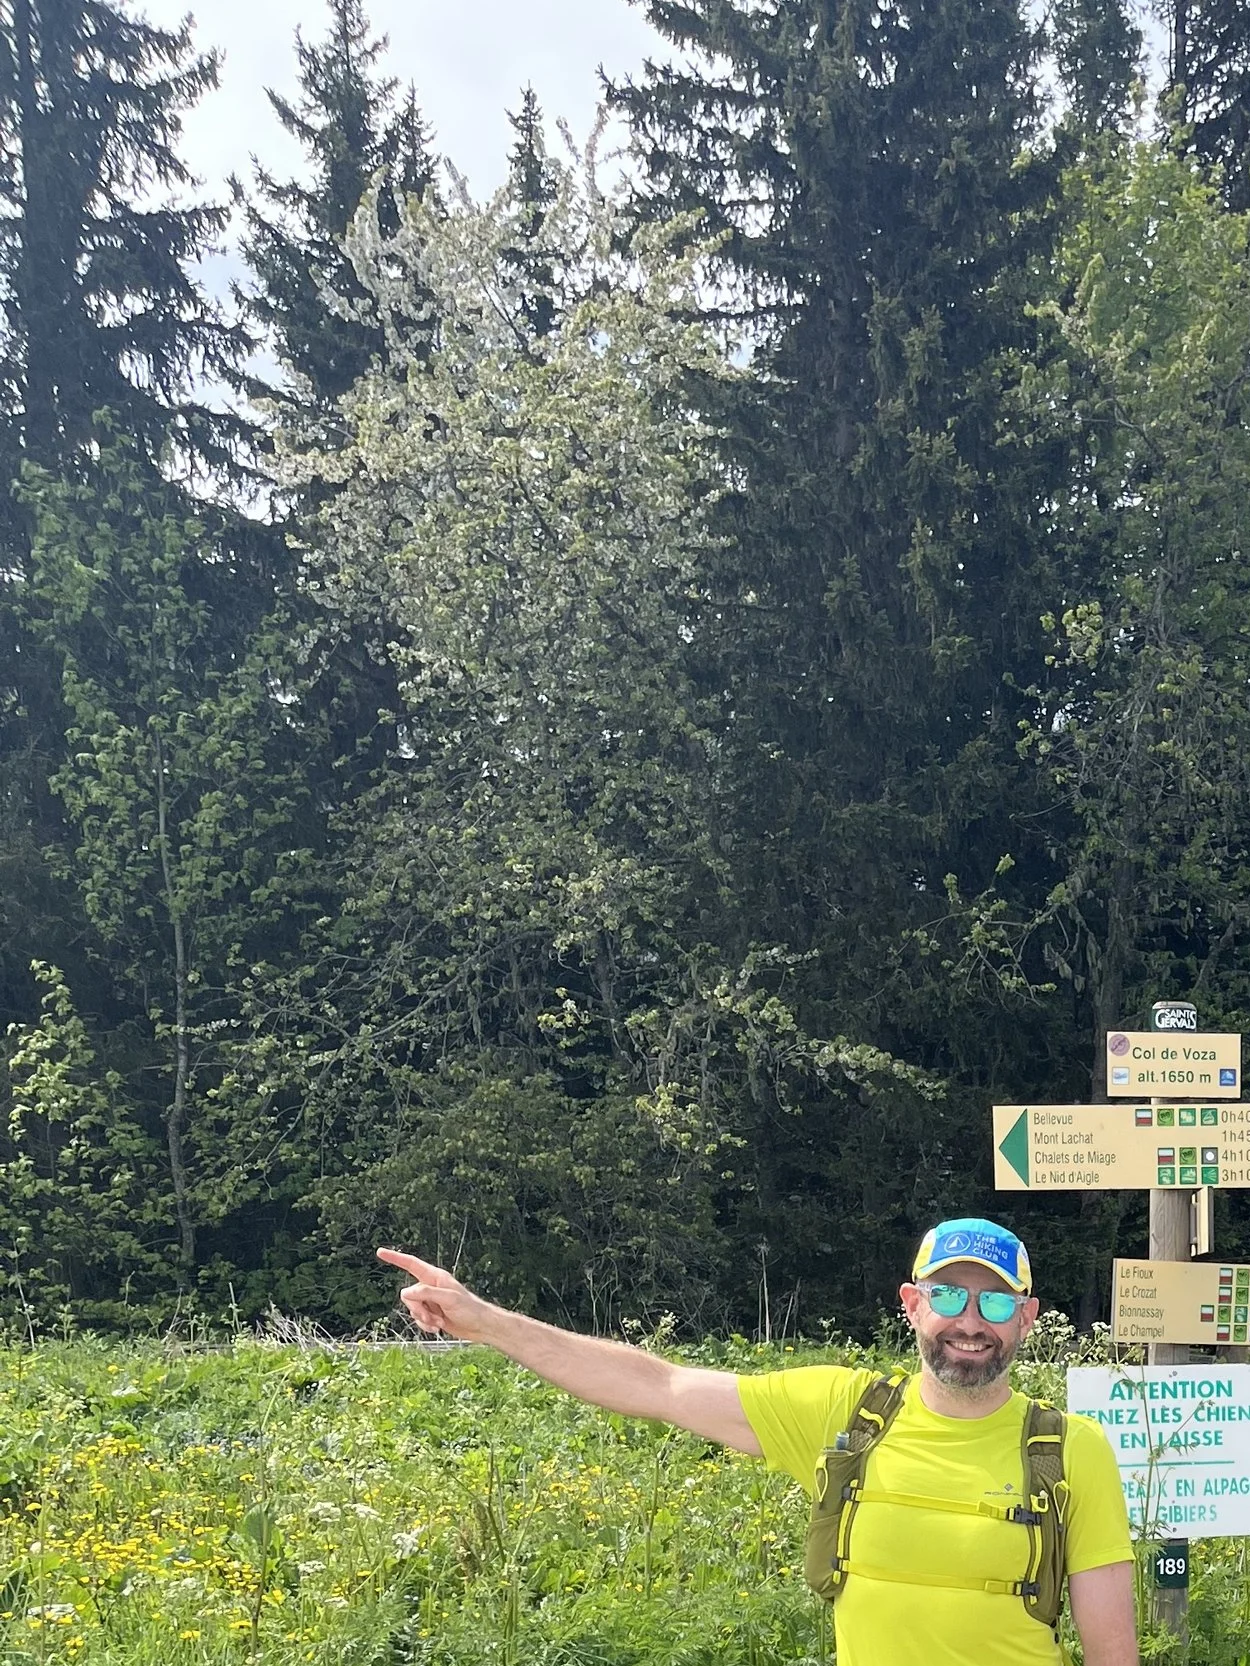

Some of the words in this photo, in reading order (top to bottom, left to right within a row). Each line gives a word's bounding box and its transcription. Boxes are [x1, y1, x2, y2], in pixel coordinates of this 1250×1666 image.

[1132, 1047, 1155, 1060] Col
[1161, 1048, 1177, 1060] de
[1183, 1048, 1216, 1060] Voza
[1199, 1073, 1211, 1083] m
[1033, 1113, 1073, 1125] Bellevue
[1034, 1132, 1058, 1144] Mont
[1061, 1132, 1094, 1144] Lachat
[1035, 1152, 1070, 1164] Chalets
[1073, 1152, 1084, 1163] de
[1087, 1151, 1117, 1166] Miage
[1035, 1172, 1046, 1183] Le
[1050, 1171, 1066, 1183] Nid
[1068, 1171, 1100, 1185] d'Aigle
[975, 1233, 997, 1244] THE
[972, 1248, 999, 1260] CLUB
[973, 1241, 1009, 1260] HIKING
[1120, 1266, 1130, 1278] Le
[1132, 1266, 1154, 1279] Fioux
[1120, 1286, 1130, 1298] Le
[1132, 1285, 1157, 1299] Crozat
[1119, 1304, 1164, 1320] Bionnassay
[1118, 1324, 1129, 1337] Le
[1130, 1323, 1165, 1339] Champel
[1109, 1380, 1233, 1400] ATTENTION
[1120, 1433, 1146, 1449] EN
[1158, 1430, 1223, 1448] LAISSE
[1176, 1479, 1195, 1497] EN
[1159, 1504, 1217, 1523] GIBIERS
[1156, 1558, 1186, 1575] 189
